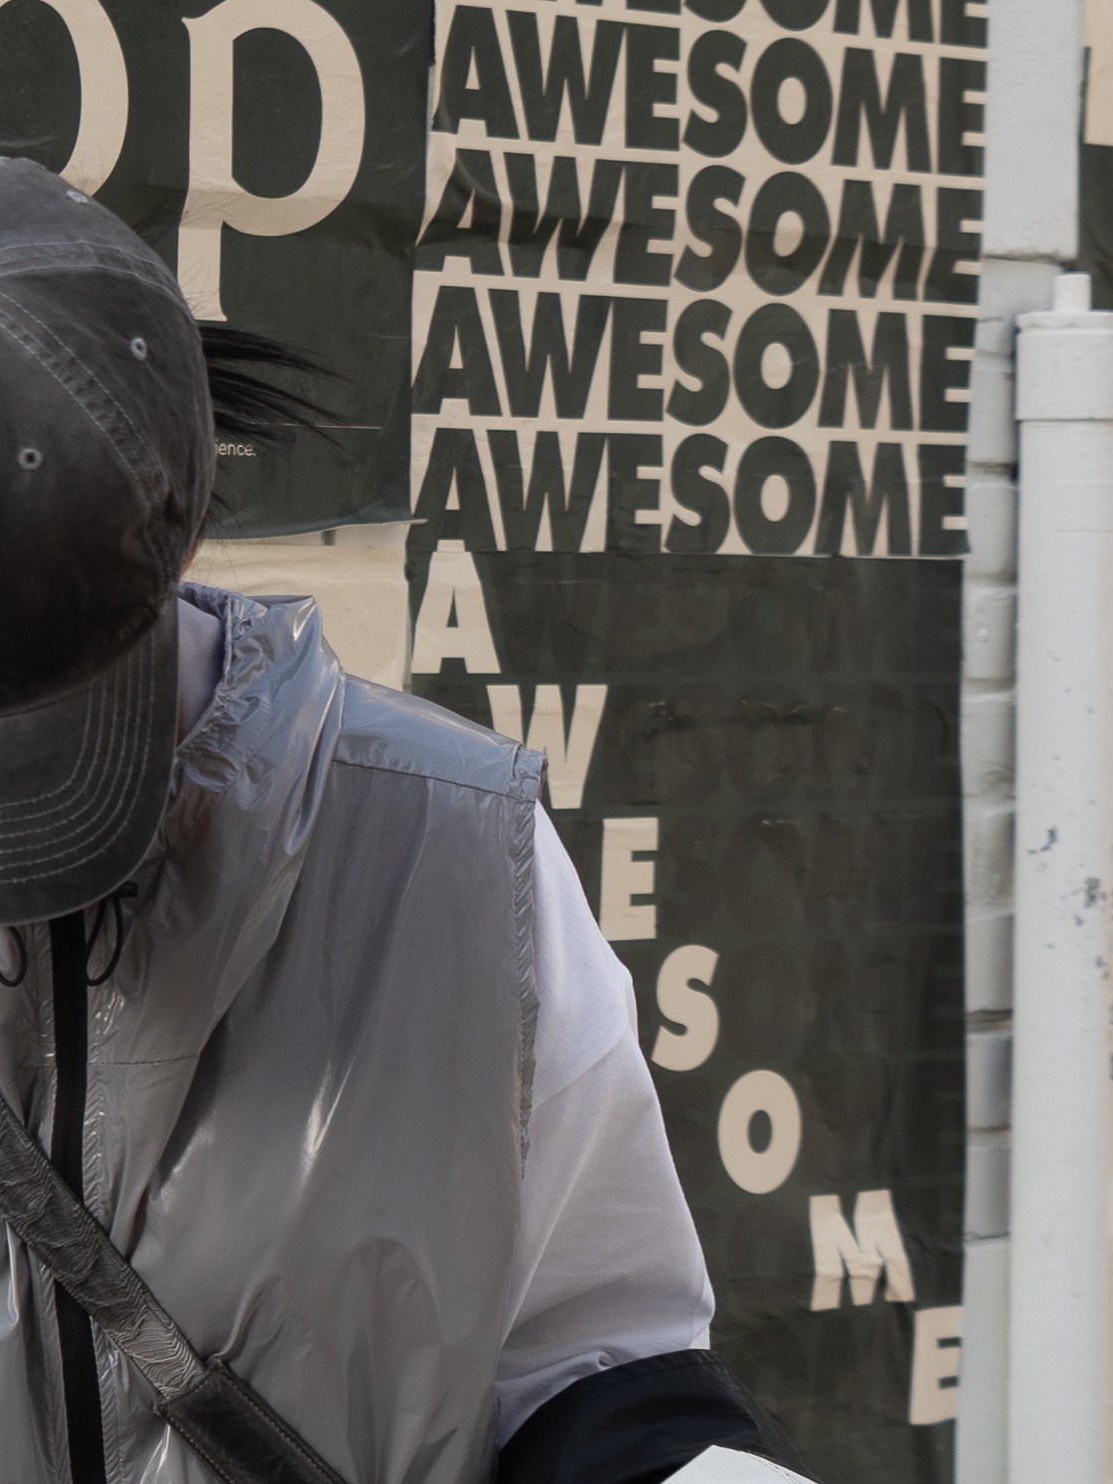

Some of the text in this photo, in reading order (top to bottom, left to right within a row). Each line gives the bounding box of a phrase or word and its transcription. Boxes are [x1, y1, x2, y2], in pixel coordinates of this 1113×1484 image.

[430, 5, 986, 177] AWESOME
[414, 148, 984, 304] AWESOME
[411, 285, 977, 433] AWESOME
[405, 427, 970, 556] AWESOME
